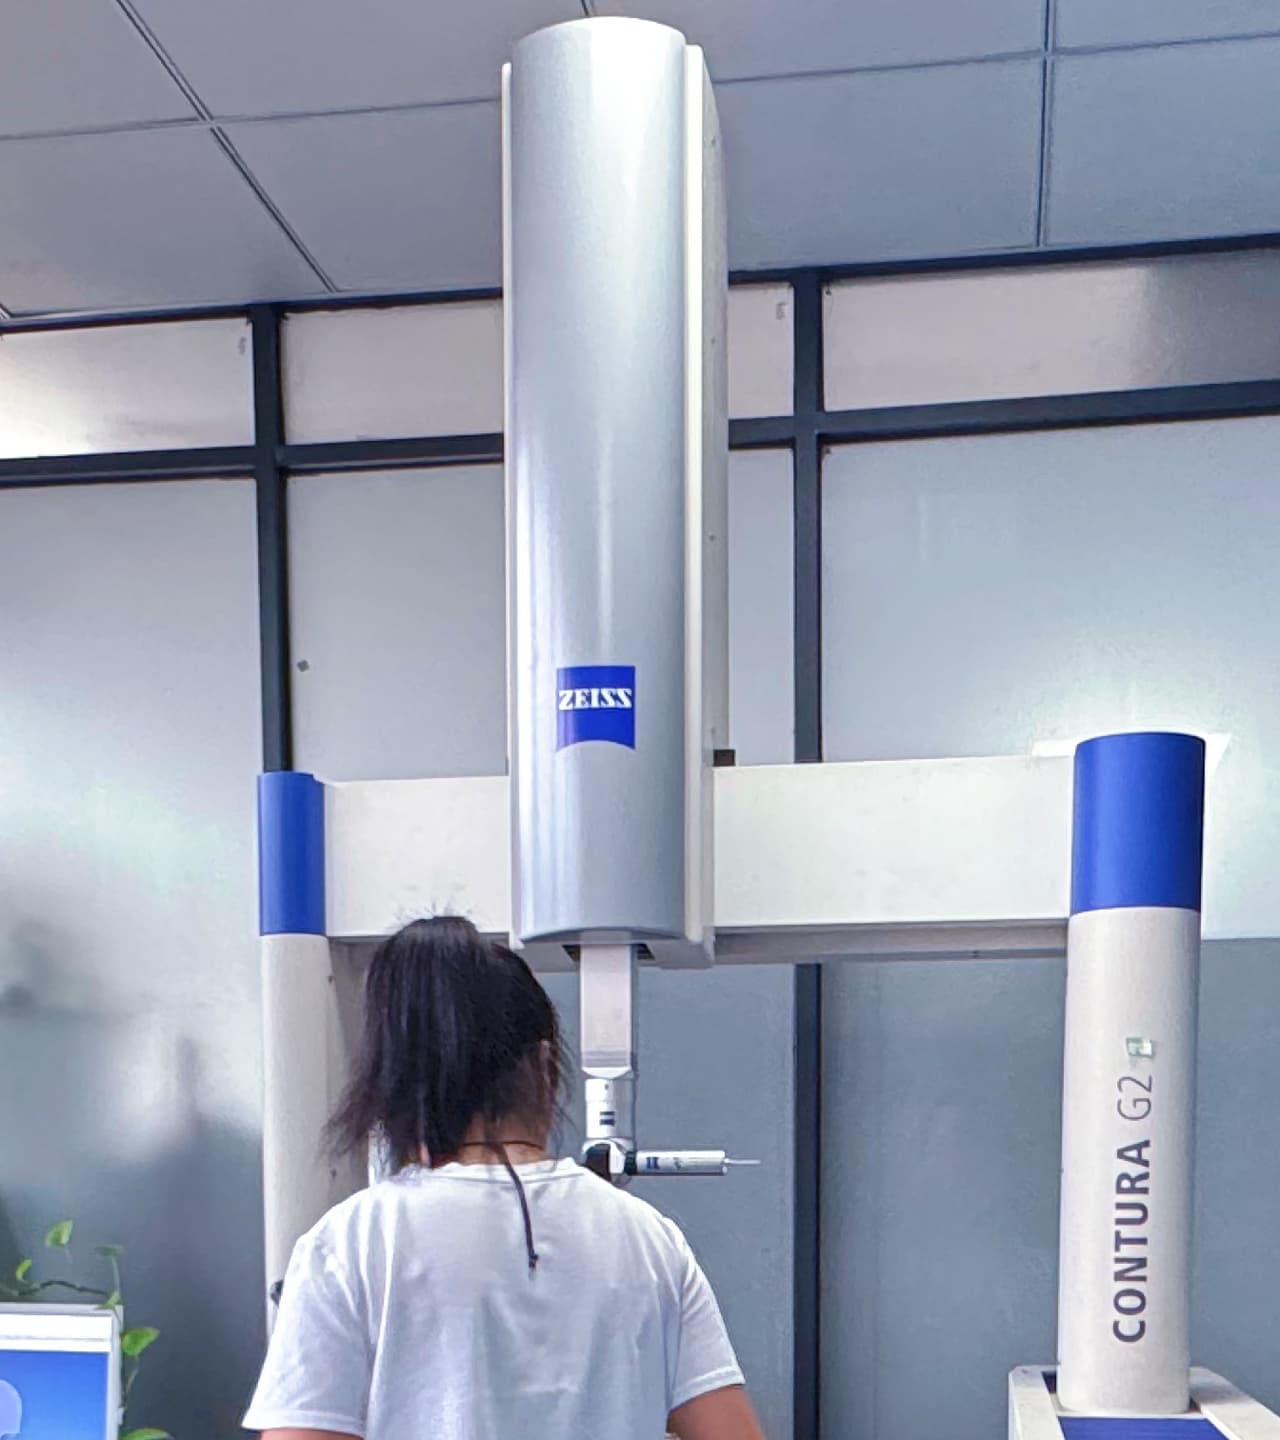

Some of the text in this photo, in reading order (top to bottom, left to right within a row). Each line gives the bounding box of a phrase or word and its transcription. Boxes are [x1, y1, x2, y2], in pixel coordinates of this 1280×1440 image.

[558, 687, 632, 711] ZEISS
[1113, 1075, 1153, 1343] CONTURA G2
